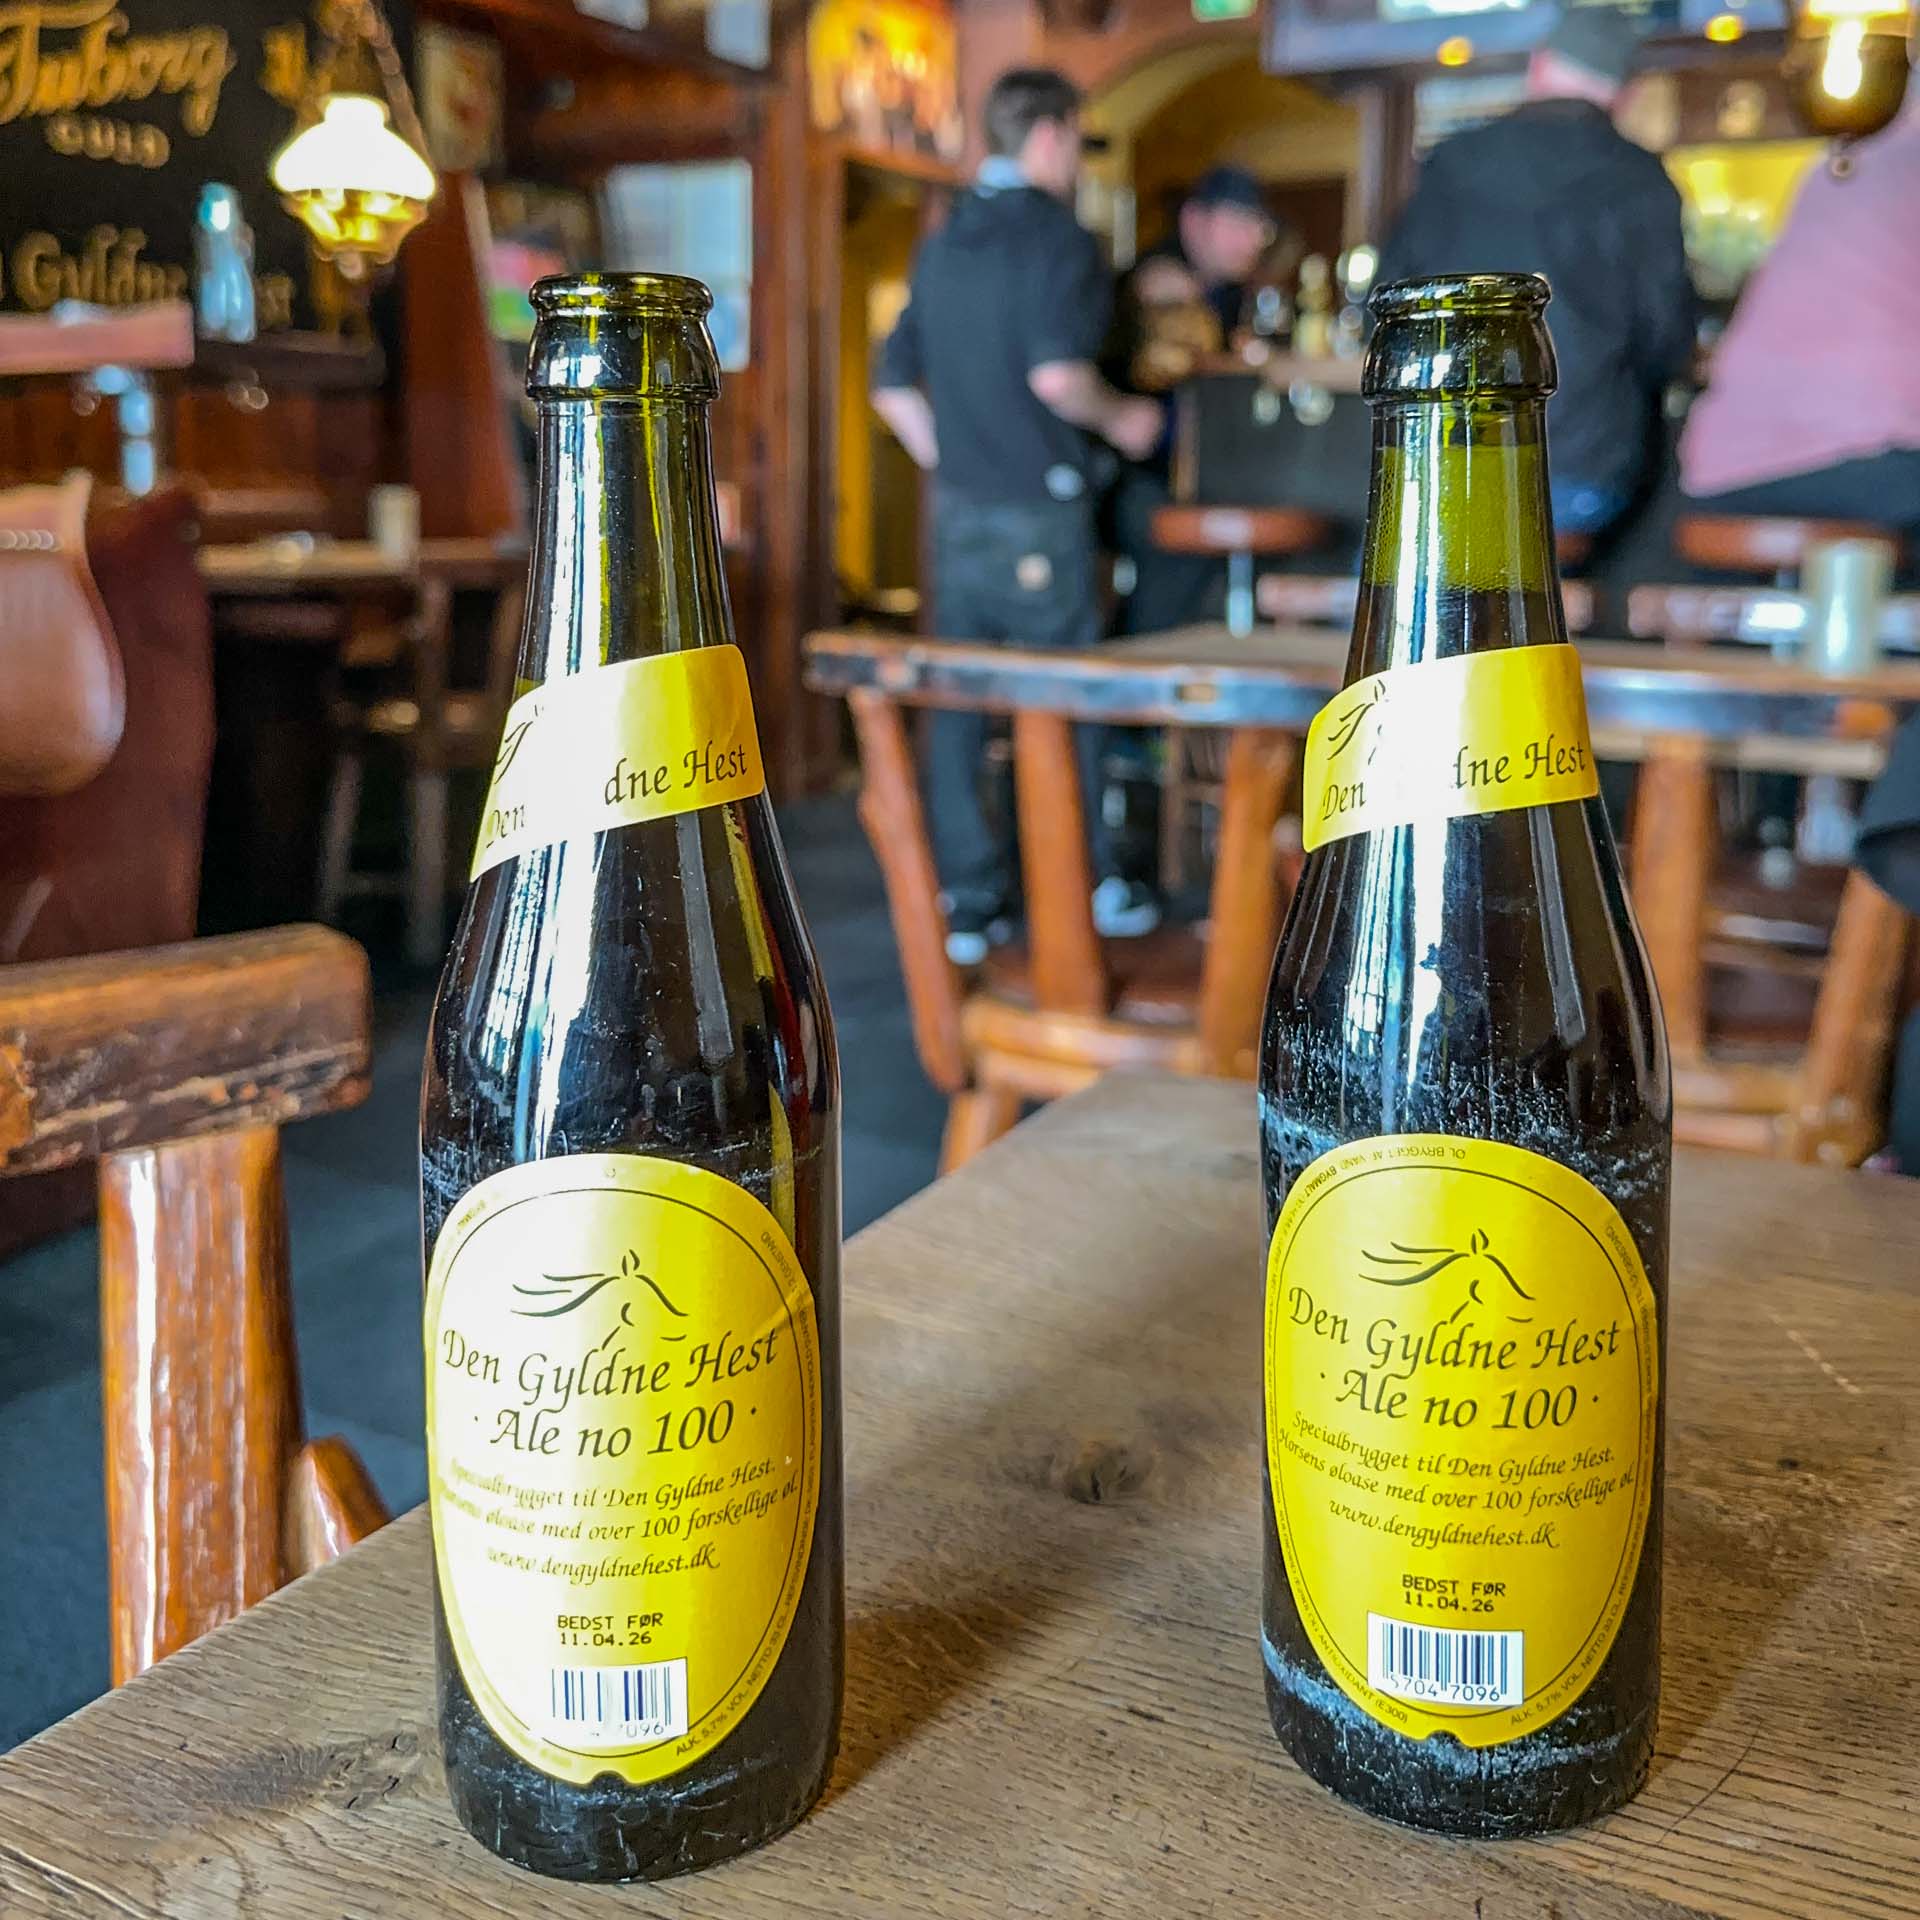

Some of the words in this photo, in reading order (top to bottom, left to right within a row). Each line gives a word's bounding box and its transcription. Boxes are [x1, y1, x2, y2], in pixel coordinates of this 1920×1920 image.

[683, 740, 747, 788] Hest
[1322, 781, 1367, 821] Den
[1524, 734, 1585, 779] Hest
[1304, 1165, 1337, 1197] BYGMALT
[1288, 1287, 1350, 1344] Den
[1366, 1318, 1516, 1379] Gyldne
[1531, 1318, 1620, 1369] Hest
[443, 1329, 500, 1383] Den
[518, 1347, 671, 1412] Gyldne
[685, 1328, 778, 1387] Hest
[1336, 1369, 1407, 1419] Ale
[1423, 1395, 1477, 1428] no
[1492, 1385, 1577, 1429] 100
[490, 1408, 560, 1455] Ale
[578, 1426, 631, 1458] no
[647, 1400, 734, 1455] 100
[1293, 1410, 1409, 1471] Specialbrygget
[1417, 1453, 1446, 1474] til
[1448, 1457, 1492, 1477] Den
[1498, 1454, 1566, 1485] Gyldne
[1571, 1446, 1615, 1472] Hest.
[573, 1486, 597, 1507] til
[603, 1488, 647, 1508] Den
[655, 1473, 724, 1511] Gyldne
[730, 1457, 775, 1489] Hest.
[1279, 1428, 1327, 1472] Horsens
[1329, 1462, 1379, 1493] øloase
[1386, 1483, 1429, 1503] med
[1432, 1491, 1477, 1509] over
[1482, 1489, 1522, 1510] 100
[1523, 1475, 1616, 1517] forskellige
[542, 1520, 583, 1540] med
[588, 1523, 635, 1541] over
[641, 1515, 681, 1539] 100
[682, 1488, 778, 1541] forskellige
[1329, 1500, 1561, 1550] www.dengyldnehest.dk
[1402, 1573, 1459, 1595] BEDST
[1471, 1581, 1507, 1597] FØR
[1404, 1590, 1495, 1613] 11.04.26
[557, 1614, 614, 1630] BEDST
[627, 1612, 664, 1629] FØR
[560, 1630, 652, 1646] 11.04.26
[747, 1649, 773, 1686] NETTO
[1581, 1629, 1606, 1669] NETTO
[1375, 1699, 1409, 1723] (E300)
[1450, 1684, 1500, 1701] 7096
